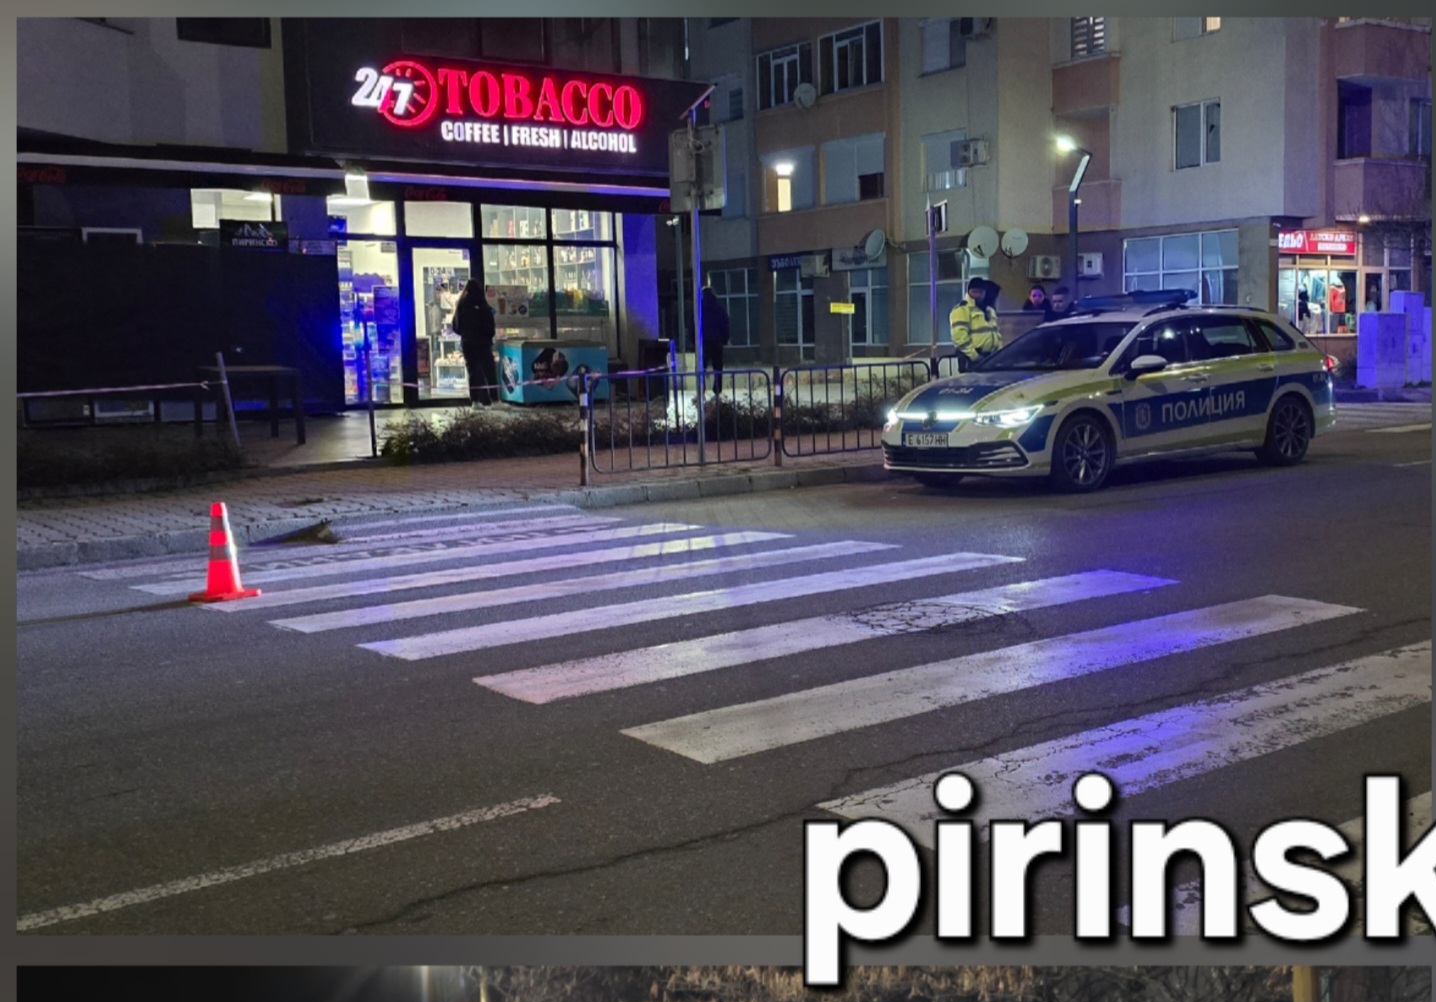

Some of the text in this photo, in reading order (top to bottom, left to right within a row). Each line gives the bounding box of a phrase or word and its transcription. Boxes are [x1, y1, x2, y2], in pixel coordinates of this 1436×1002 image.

[438, 68, 642, 129] TOBACCO
[441, 121, 637, 153] COFFEE FRESH ALCOHOL
[1161, 390, 1245, 424] ПОЛИЦИЯ
